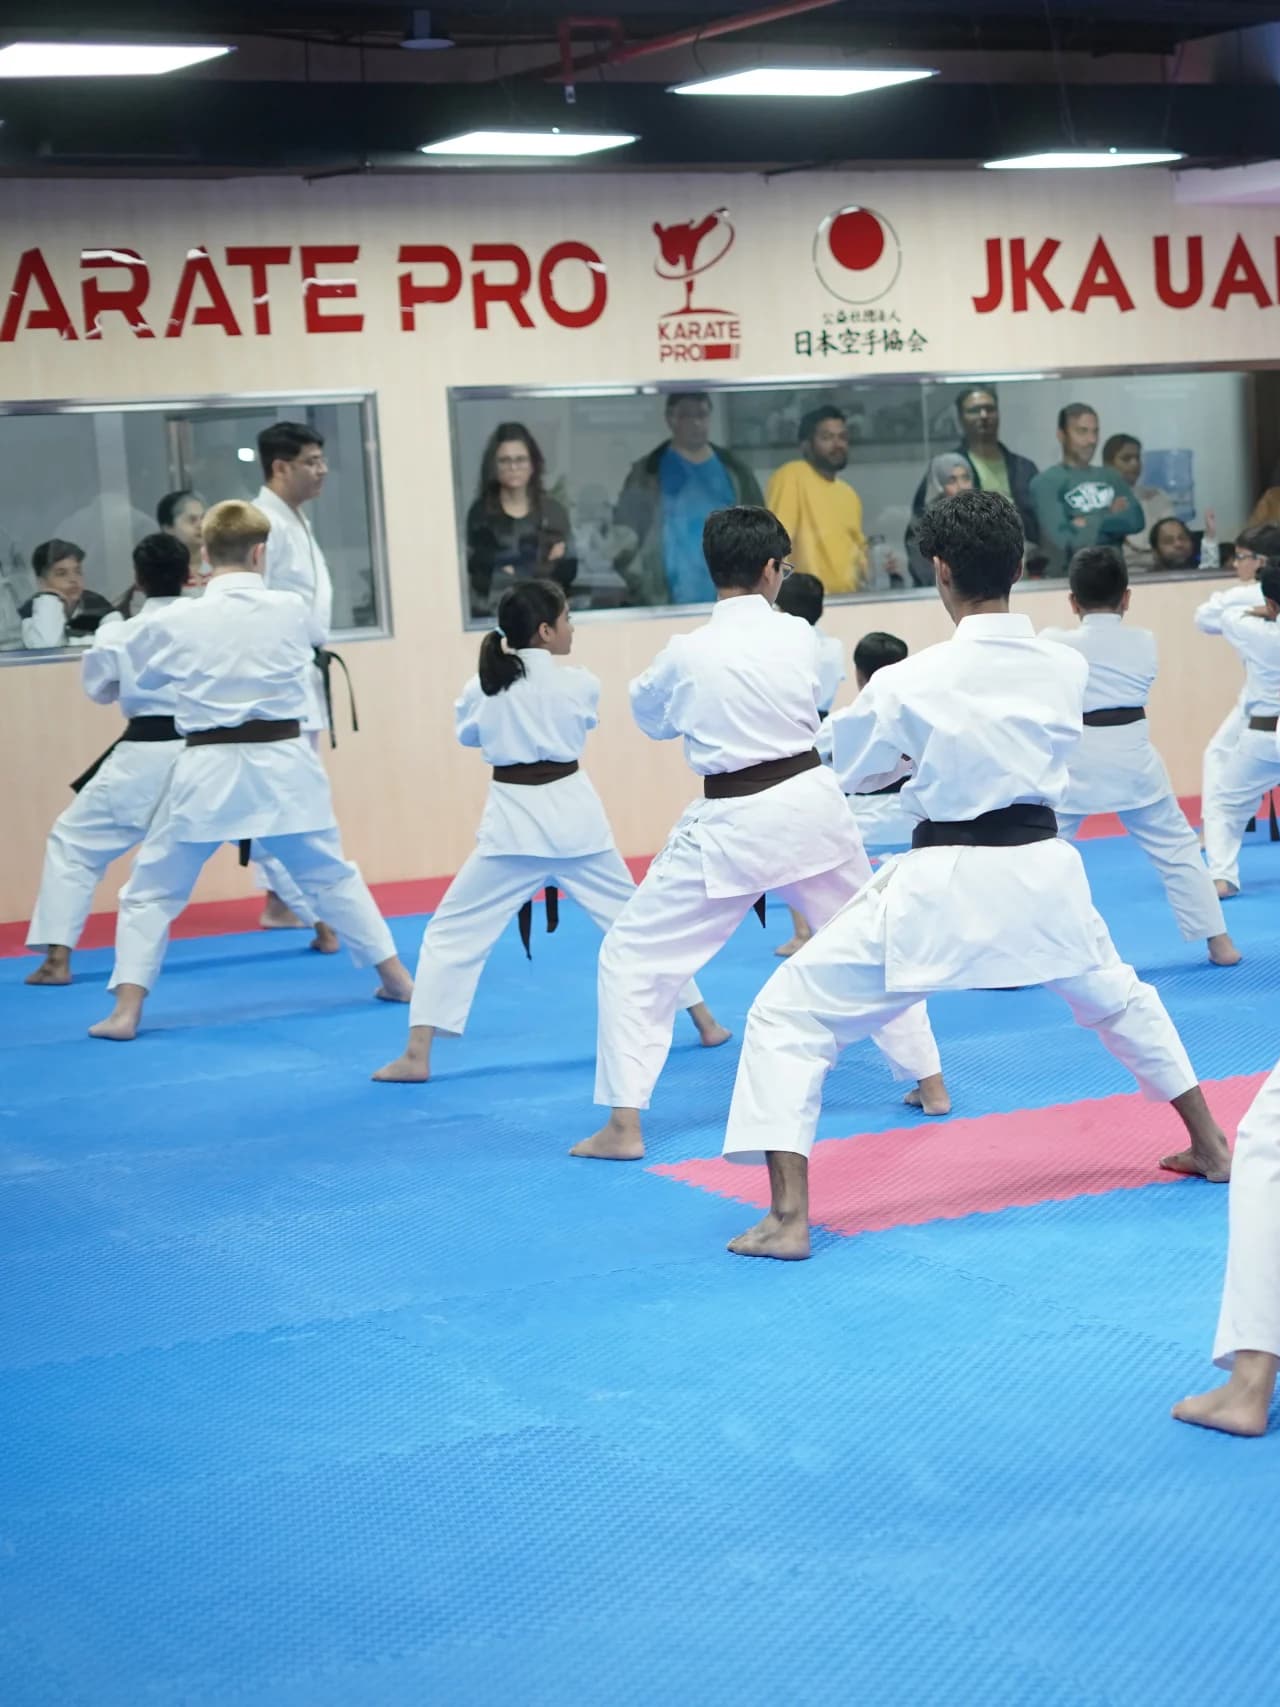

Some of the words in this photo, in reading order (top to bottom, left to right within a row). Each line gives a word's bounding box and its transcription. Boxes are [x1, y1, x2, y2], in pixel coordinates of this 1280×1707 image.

[972, 233, 1136, 313] JKA
[0, 245, 364, 342] ARATE
[397, 240, 608, 331] PRO
[658, 320, 741, 341] KARATE
[794, 328, 928, 357] 日本空手協会
[660, 344, 704, 362] PRO
